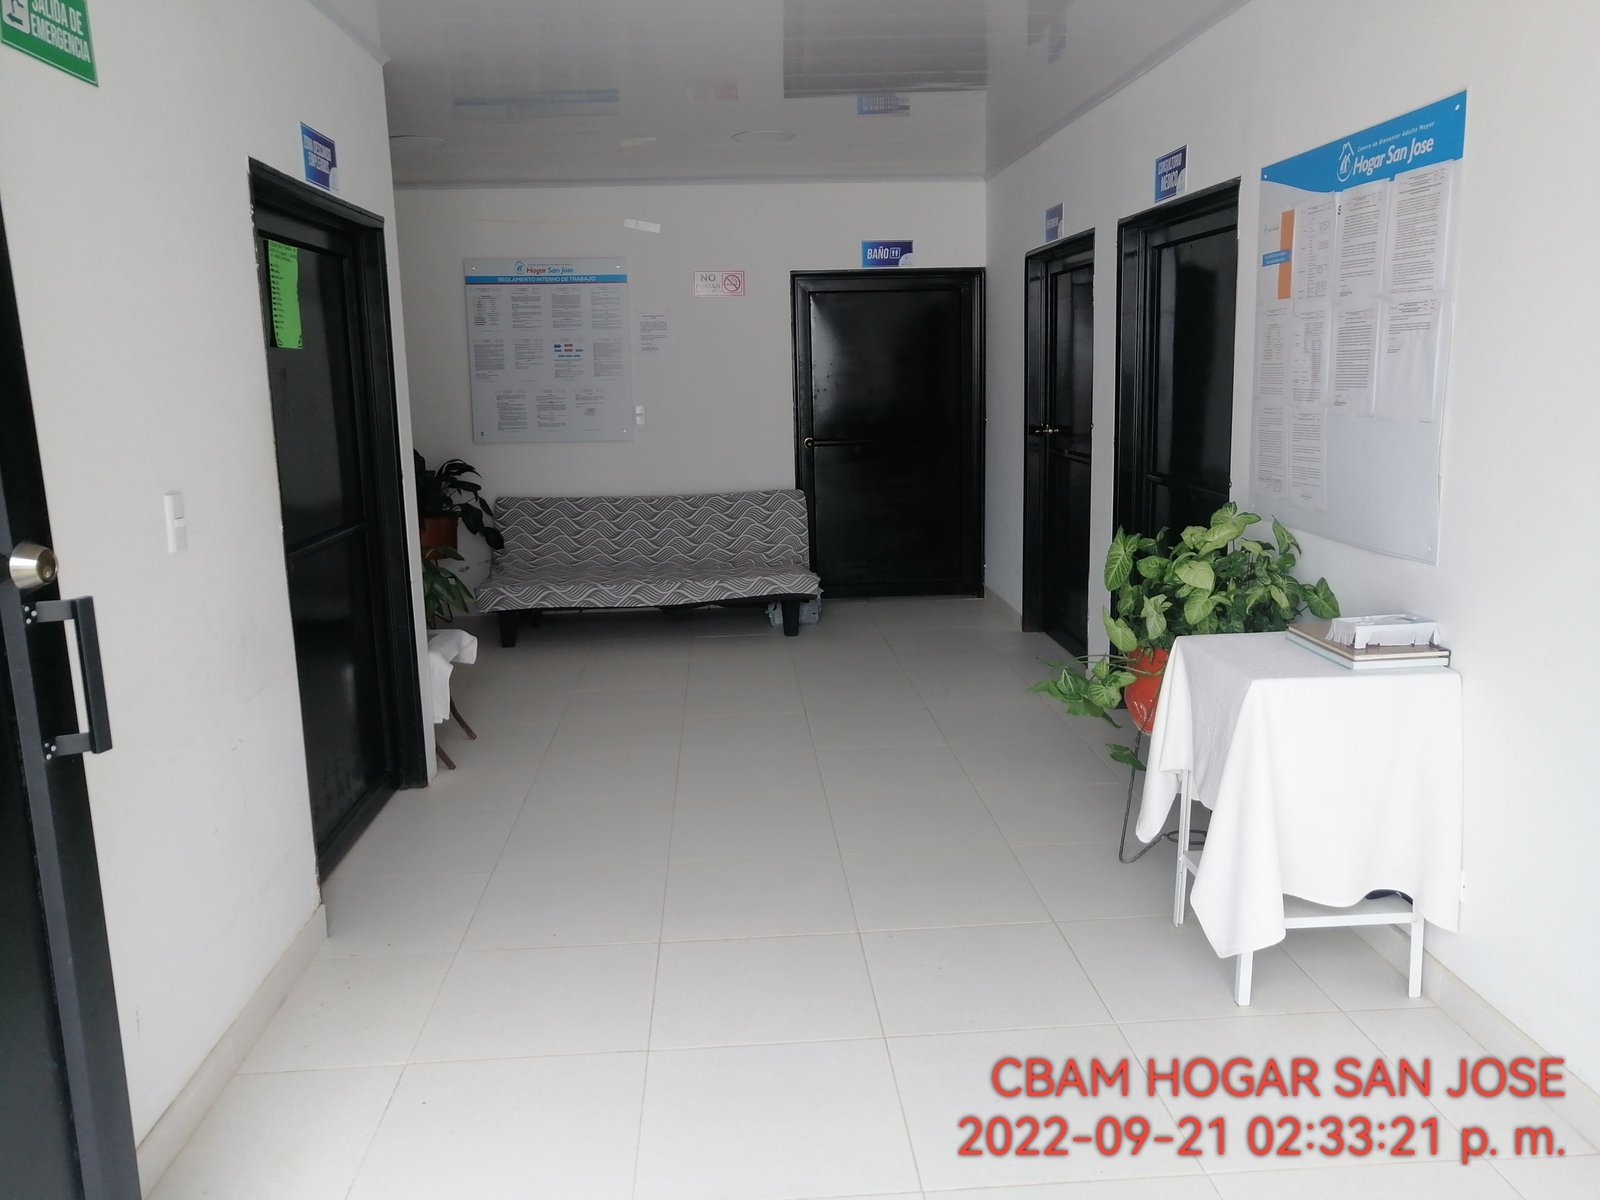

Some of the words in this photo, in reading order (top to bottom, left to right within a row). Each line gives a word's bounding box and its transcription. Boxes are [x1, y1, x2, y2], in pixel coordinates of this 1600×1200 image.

[69, 7, 84, 36] DE
[30, 12, 91, 63] EMERGENCIA
[1352, 153, 1385, 176] Hogar
[1386, 144, 1407, 165] San
[1407, 137, 1434, 164] Jose
[867, 246, 889, 260] BAÑO
[526, 266, 546, 274] Hogar
[547, 266, 560, 274] San
[700, 273, 716, 282] NO
